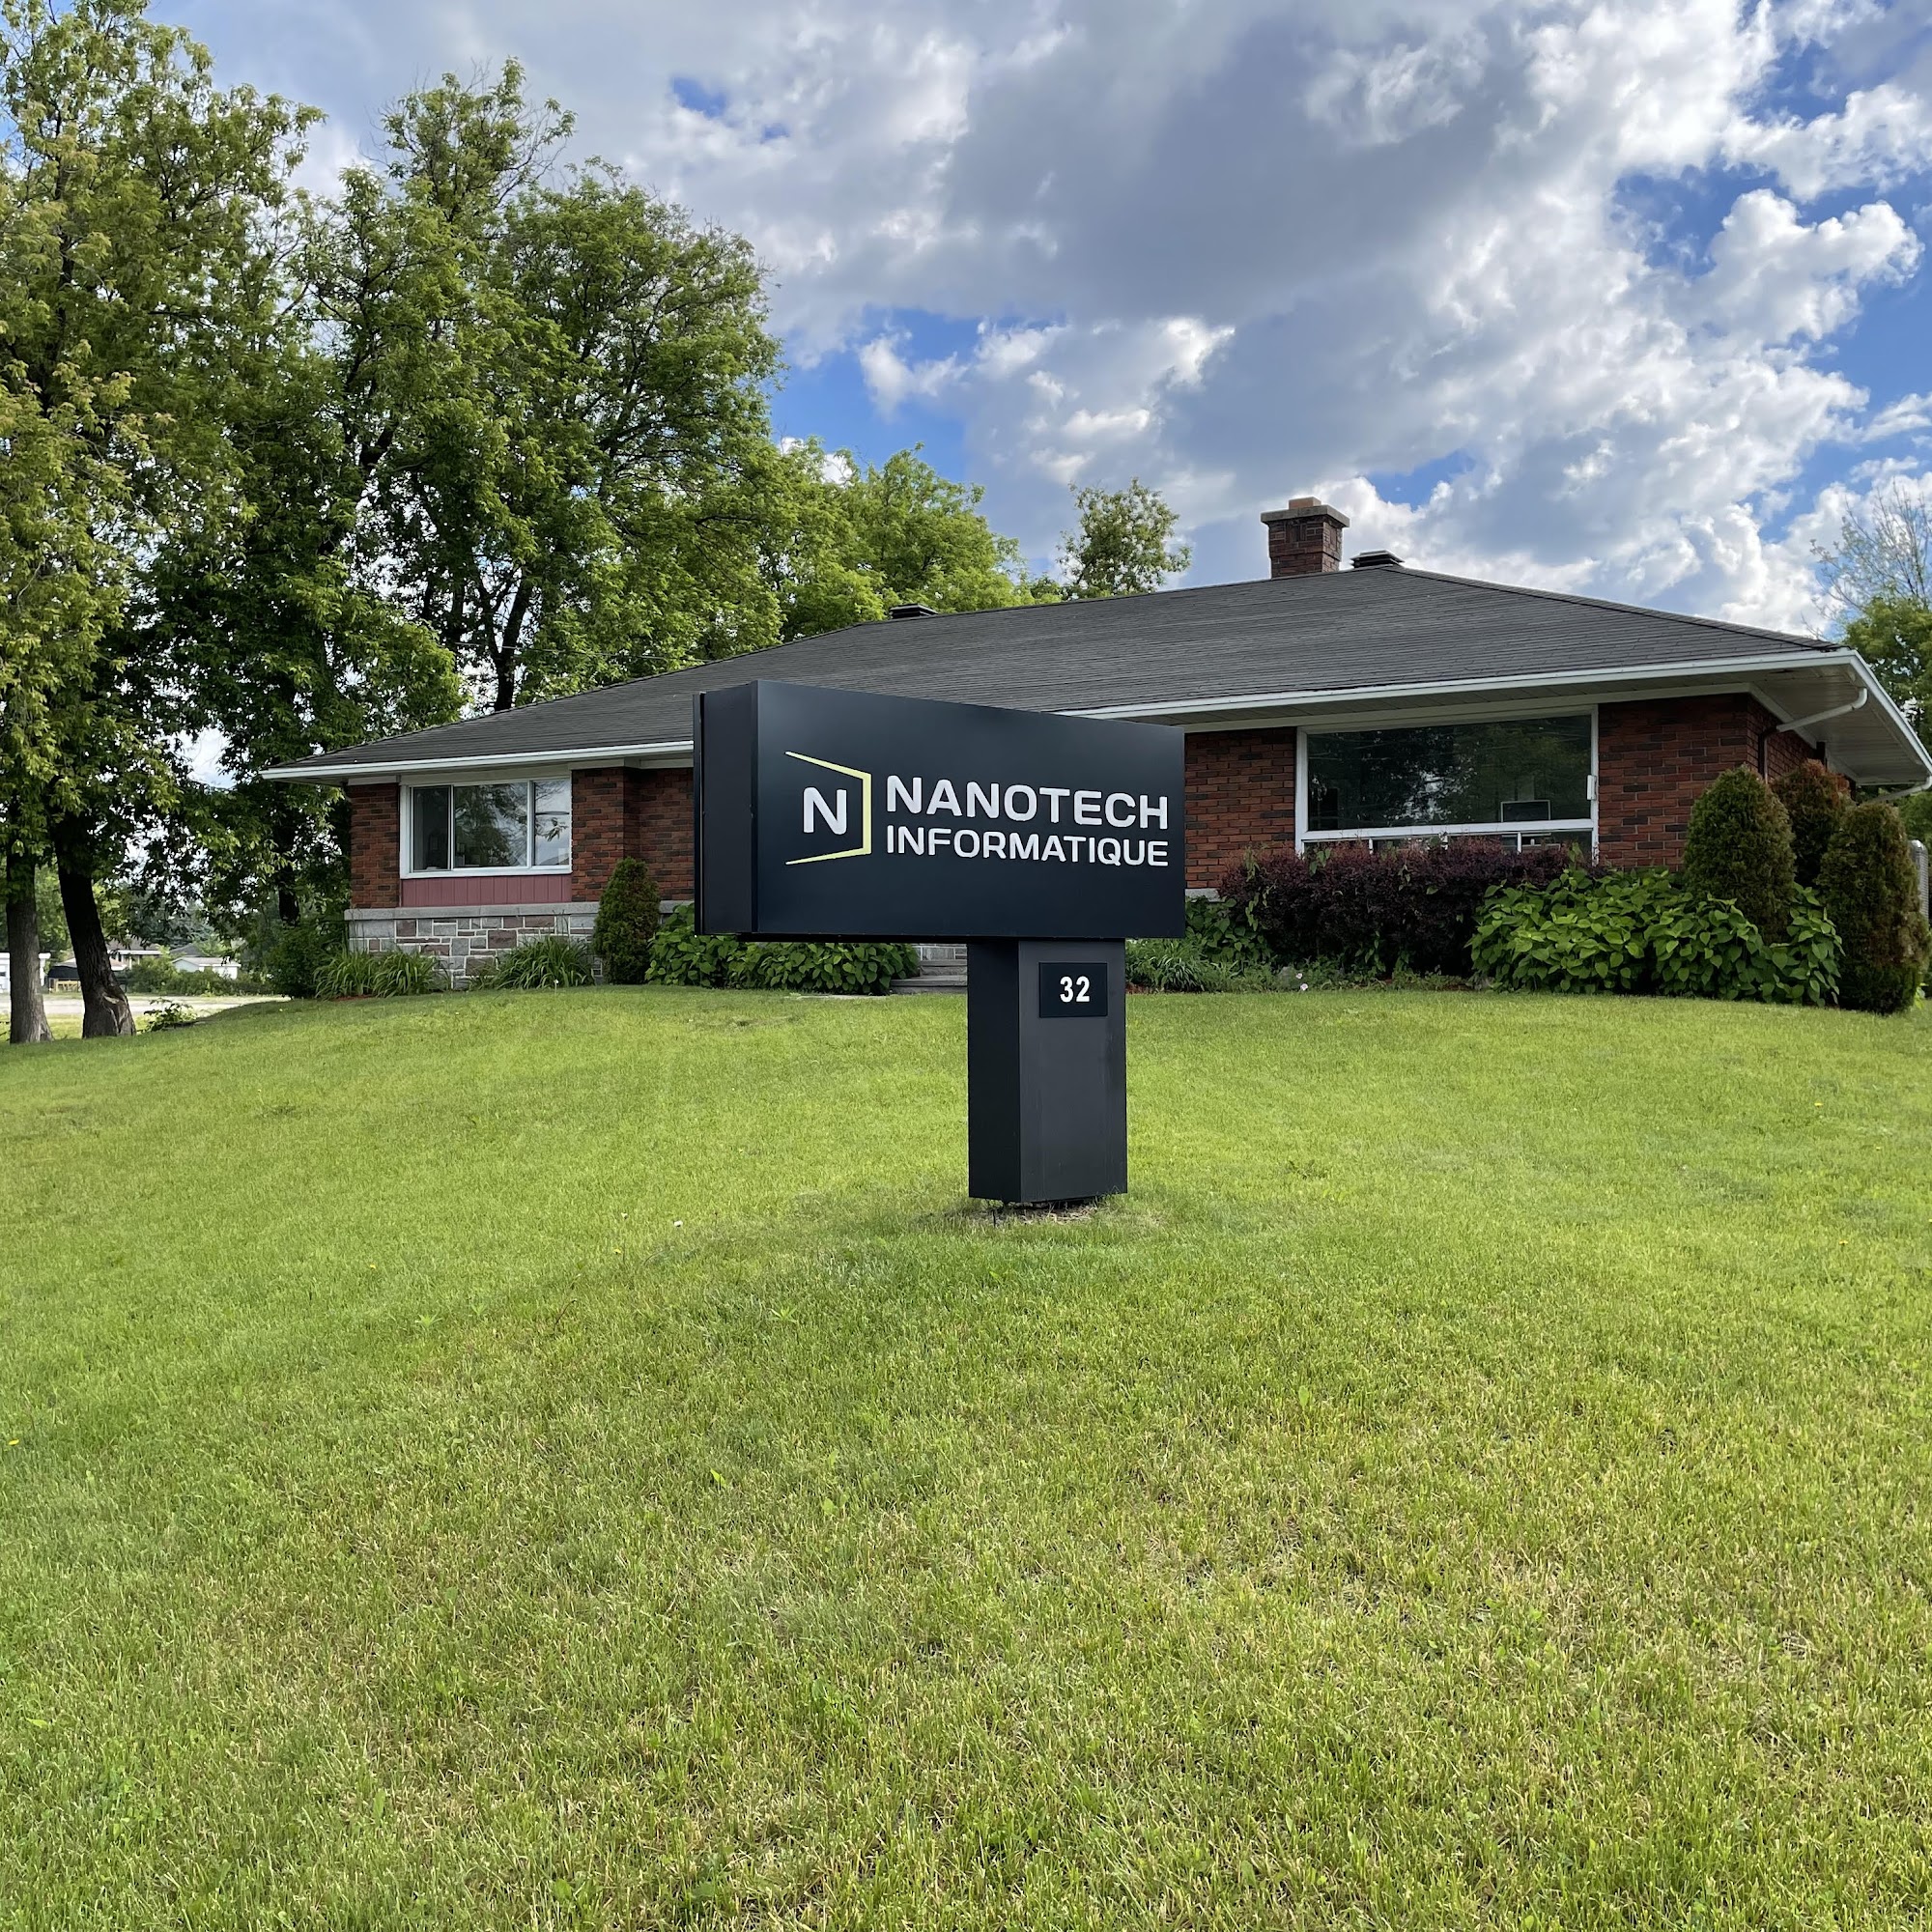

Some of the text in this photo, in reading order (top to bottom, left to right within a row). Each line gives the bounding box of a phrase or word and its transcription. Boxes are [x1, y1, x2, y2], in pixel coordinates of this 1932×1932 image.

[803, 786, 847, 836] N
[887, 775, 1169, 830] NANOTECH
[887, 824, 1169, 867] INFORMATIQUE
[1059, 976, 1091, 1003] 32
